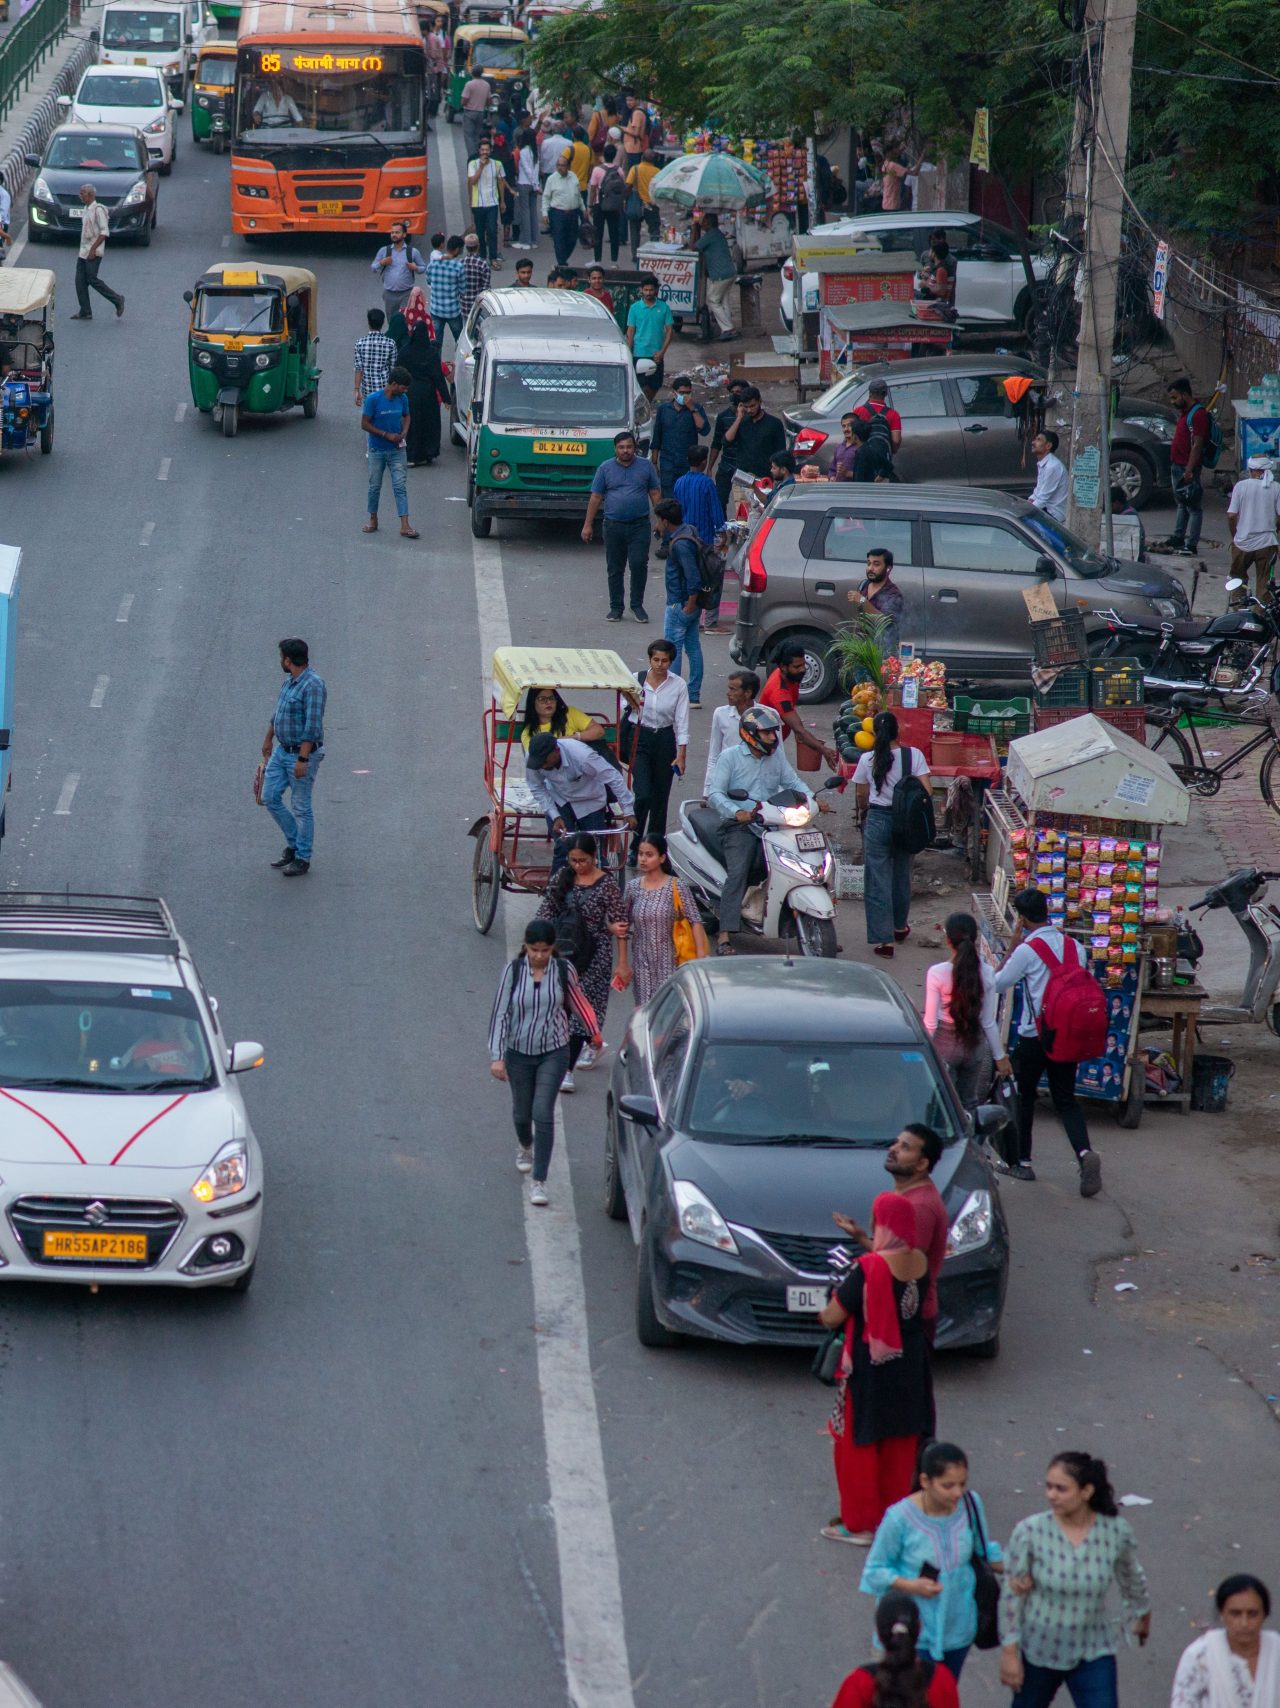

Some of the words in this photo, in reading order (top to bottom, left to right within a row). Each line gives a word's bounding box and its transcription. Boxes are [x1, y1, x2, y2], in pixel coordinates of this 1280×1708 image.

[261, 54, 281, 72] 85
[539, 443, 548, 451] DL
[551, 444, 556, 452] 2
[566, 444, 584, 452] 4441
[55, 1237, 145, 1254] HR55AP2186
